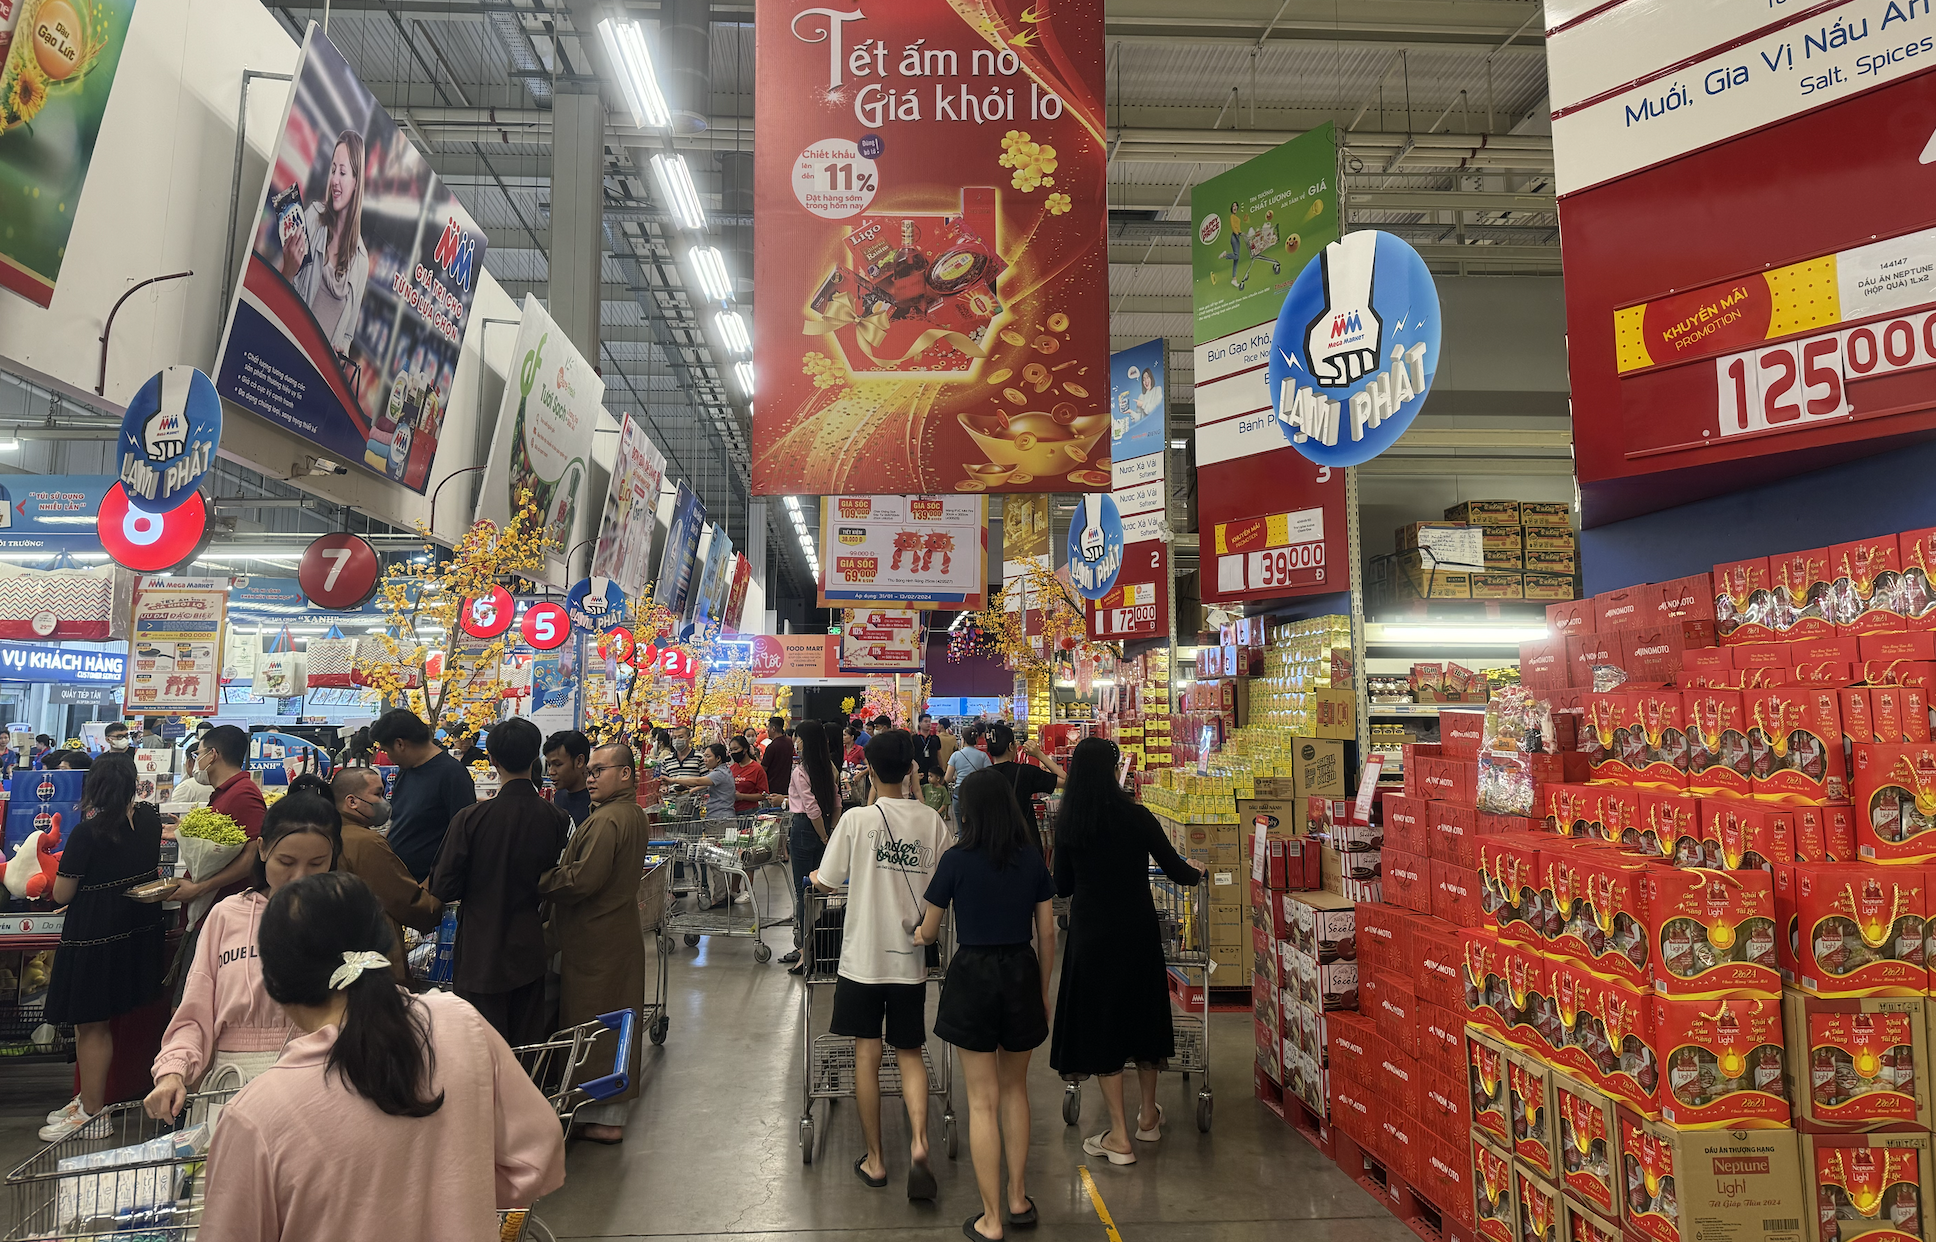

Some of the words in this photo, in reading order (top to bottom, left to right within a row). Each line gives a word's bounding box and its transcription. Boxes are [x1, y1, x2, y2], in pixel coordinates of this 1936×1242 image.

[37, 24, 58, 48] Gạo
[55, 22, 70, 39] Dầu
[791, 7, 888, 91] Tết
[898, 38, 959, 77] ấm
[971, 48, 1021, 77] no
[1624, 82, 1694, 128] Muối,
[1704, 65, 1750, 95] Gia
[1761, 42, 1794, 72] Vị
[1805, 15, 1869, 59] Nấu
[1799, 65, 1849, 96] Salt,
[1856, 36, 1934, 76] Spices
[854, 83, 922, 129] Giá
[934, 83, 1014, 125] khỏi
[1030, 83, 1063, 122] lo
[801, 148, 829, 159] Chiết
[831, 148, 856, 159] khấu
[1308, 178, 1327, 198] GIÁ
[806, 194, 821, 203] Đặt
[823, 194, 843, 203] hàng
[806, 202, 828, 211] trong
[830, 201, 848, 209] hôm
[850, 224, 881, 247] Ligo
[1879, 257, 1908, 270] 144147
[1857, 275, 1878, 289] DẦU
[1878, 271, 1892, 286] ĂN
[1892, 263, 1935, 282] NEPTUNE
[415, 264, 434, 292] GIÁ
[432, 278, 447, 306] TRỊ
[445, 293, 463, 319] CHO
[1863, 282, 1885, 297] (HỘP
[1886, 277, 1908, 291] QUÀ)
[393, 272, 418, 307] TỪNG
[434, 311, 458, 342] CHỌN
[1662, 300, 1718, 342] KHUYẾN
[1719, 285, 1749, 311] MÃI
[1674, 308, 1743, 351] PROMOTION
[1207, 347, 1226, 363] Bún
[1228, 341, 1248, 357] Gạo
[1250, 332, 1272, 349] Khô,
[1243, 352, 1259, 364] Rice
[1278, 377, 1341, 447] LẠM
[1348, 341, 1427, 442] PHÁT
[1238, 416, 1265, 434] Bánh
[120, 452, 160, 500] LẠM
[162, 440, 212, 499] PHÁT
[1119, 464, 1135, 475] Nước
[1139, 470, 1157, 479] Softener
[1120, 492, 1135, 503] Nước
[1139, 500, 1158, 508] Softener
[1140, 529, 1158, 537] Softener
[1231, 524, 1251, 544] KHUYẾN
[1250, 522, 1261, 533] MÃI
[1235, 532, 1258, 548] PROMOTION
[840, 558, 855, 568] GIÁ
[857, 557, 875, 569] SỐC
[1095, 544, 1120, 588] PHÁT
[1150, 551, 1160, 568] 2
[322, 548, 351, 592] 7
[1315, 568, 1325, 580] Đ
[535, 612, 556, 640] 5
[1634, 645, 1670, 657] AJINOMOTO
[2, 648, 27, 671] VỤ
[29, 649, 82, 671] KHÁCH
[84, 652, 123, 673] HÀNG
[665, 651, 678, 670] 2
[685, 658, 692, 674] 1
[1707, 907, 1724, 918] Light
[1718, 1036, 1734, 1046] Light
[1853, 1035, 1869, 1045] Light
[1704, 1146, 1718, 1154] DẦU
[1729, 1146, 1756, 1154] THƯỢNG
[1757, 1146, 1775, 1154] HẠNG
[1714, 1159, 1768, 1174] Neptune
[1716, 1178, 1746, 1198] Light
